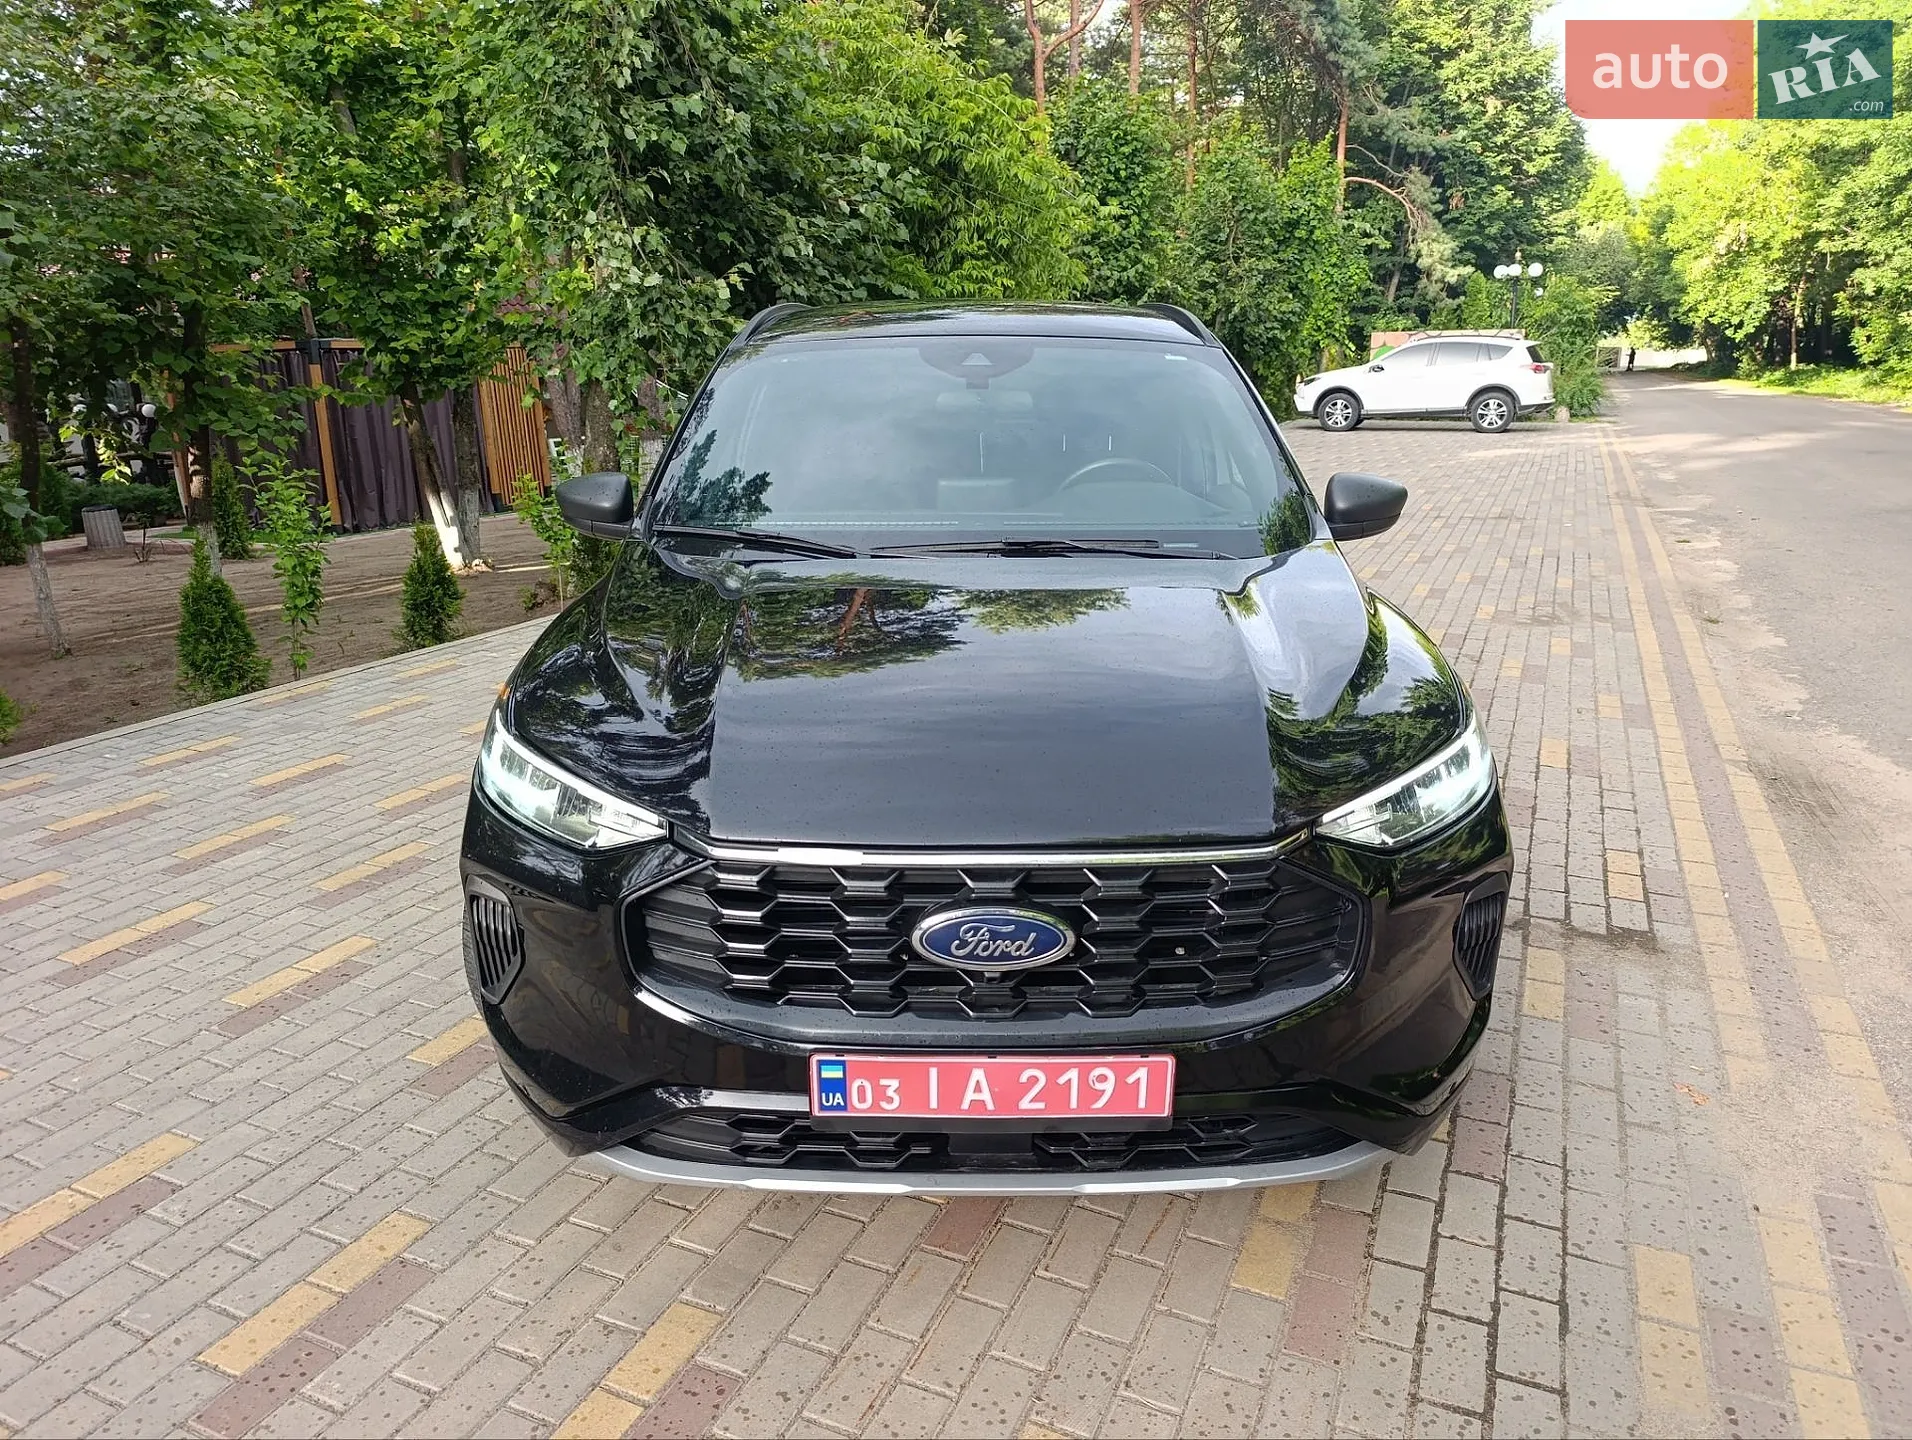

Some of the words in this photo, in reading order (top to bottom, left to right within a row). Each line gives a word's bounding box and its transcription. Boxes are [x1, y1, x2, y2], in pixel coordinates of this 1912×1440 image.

[950, 923, 1037, 957] Ford
[822, 1093, 844, 1107] UA
[851, 1078, 901, 1110] 03
[1018, 1066, 1149, 1110] 2191
